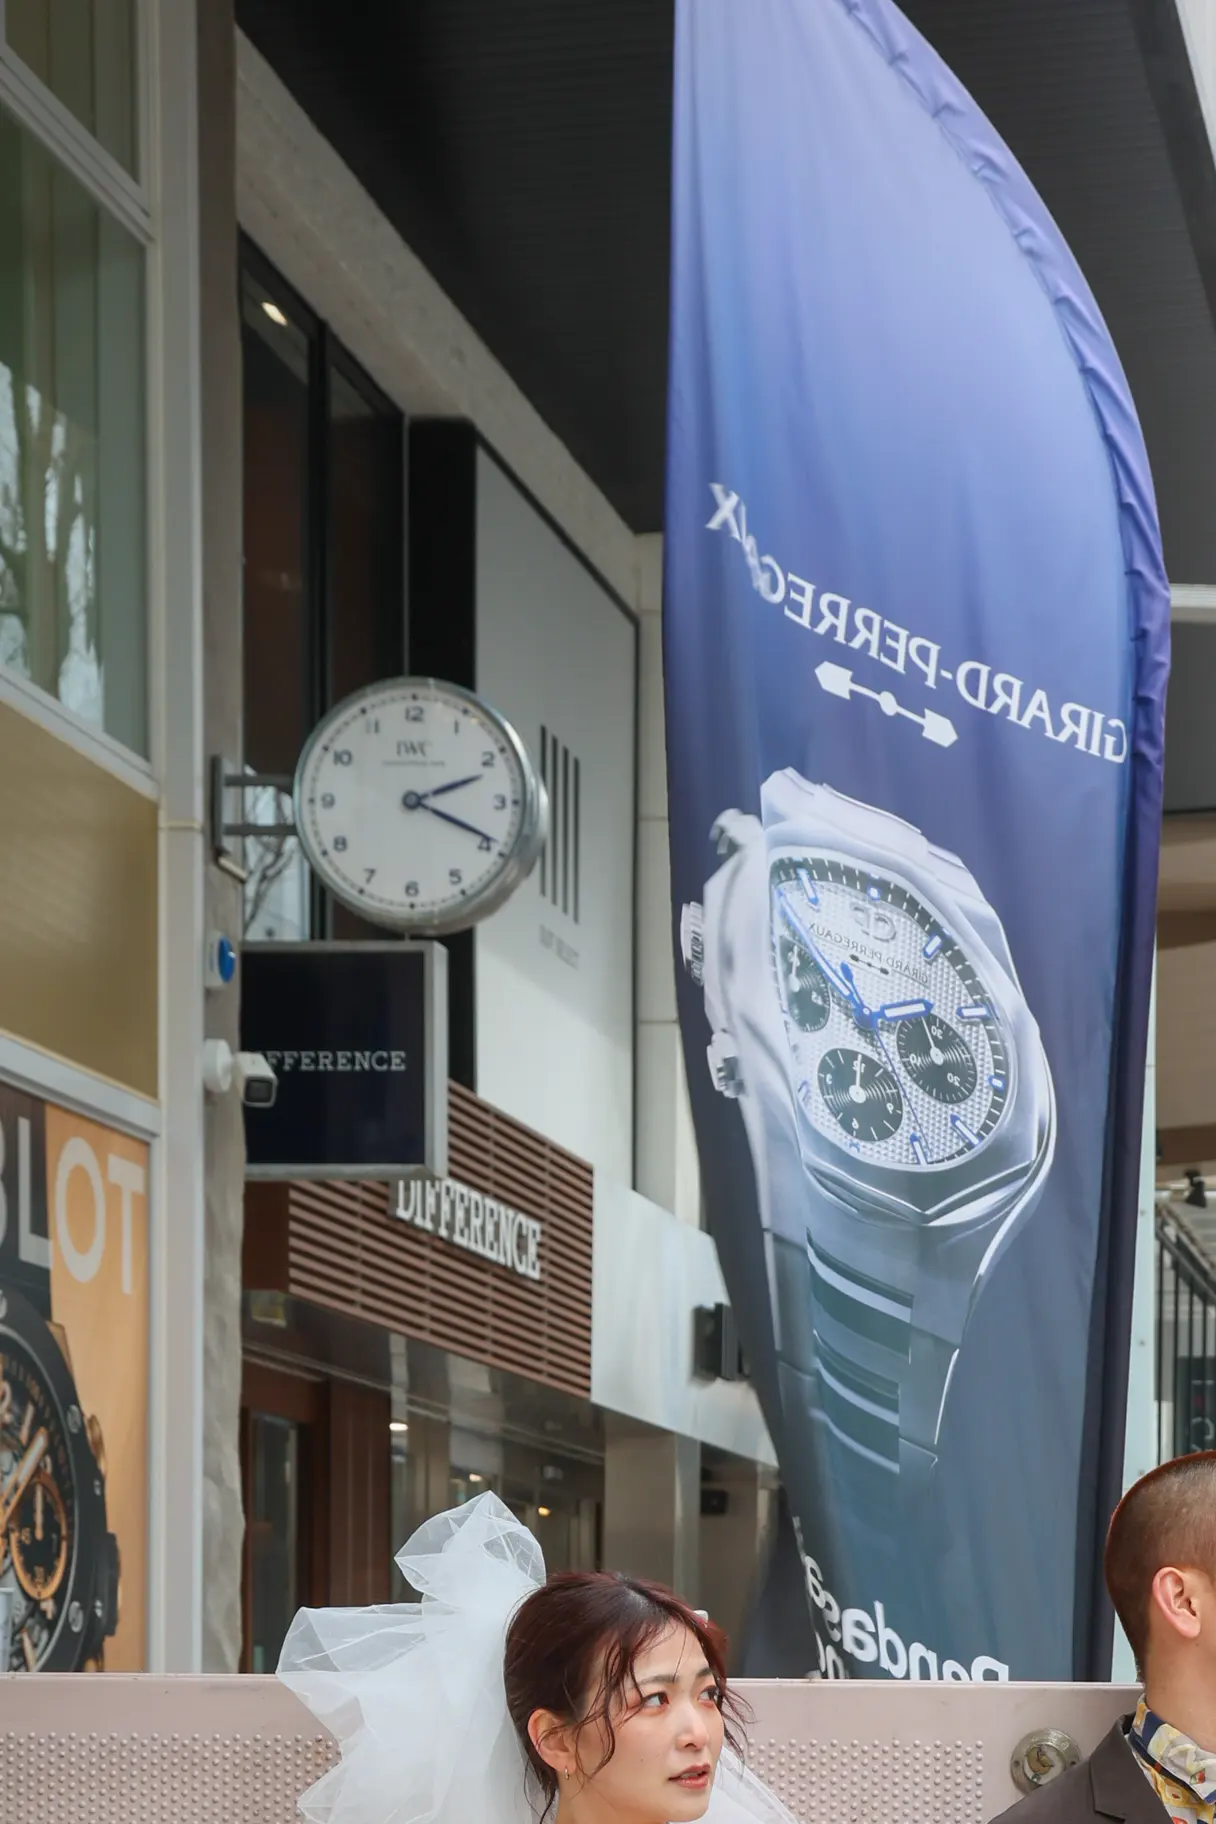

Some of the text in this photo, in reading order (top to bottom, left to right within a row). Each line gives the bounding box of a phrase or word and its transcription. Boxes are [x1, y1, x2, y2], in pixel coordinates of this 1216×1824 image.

[405, 707, 424, 722] 12
[333, 751, 352, 766] 10
[481, 752, 495, 767] 2
[321, 793, 334, 808] 9
[493, 795, 506, 810] 3
[333, 836, 347, 852] 8
[364, 868, 376, 884] 7
[449, 869, 461, 885] 5
[405, 881, 419, 897] 6
[259, 1050, 407, 1072] FFERENCE
[396, 1179, 542, 1281] DIFFERENCE
